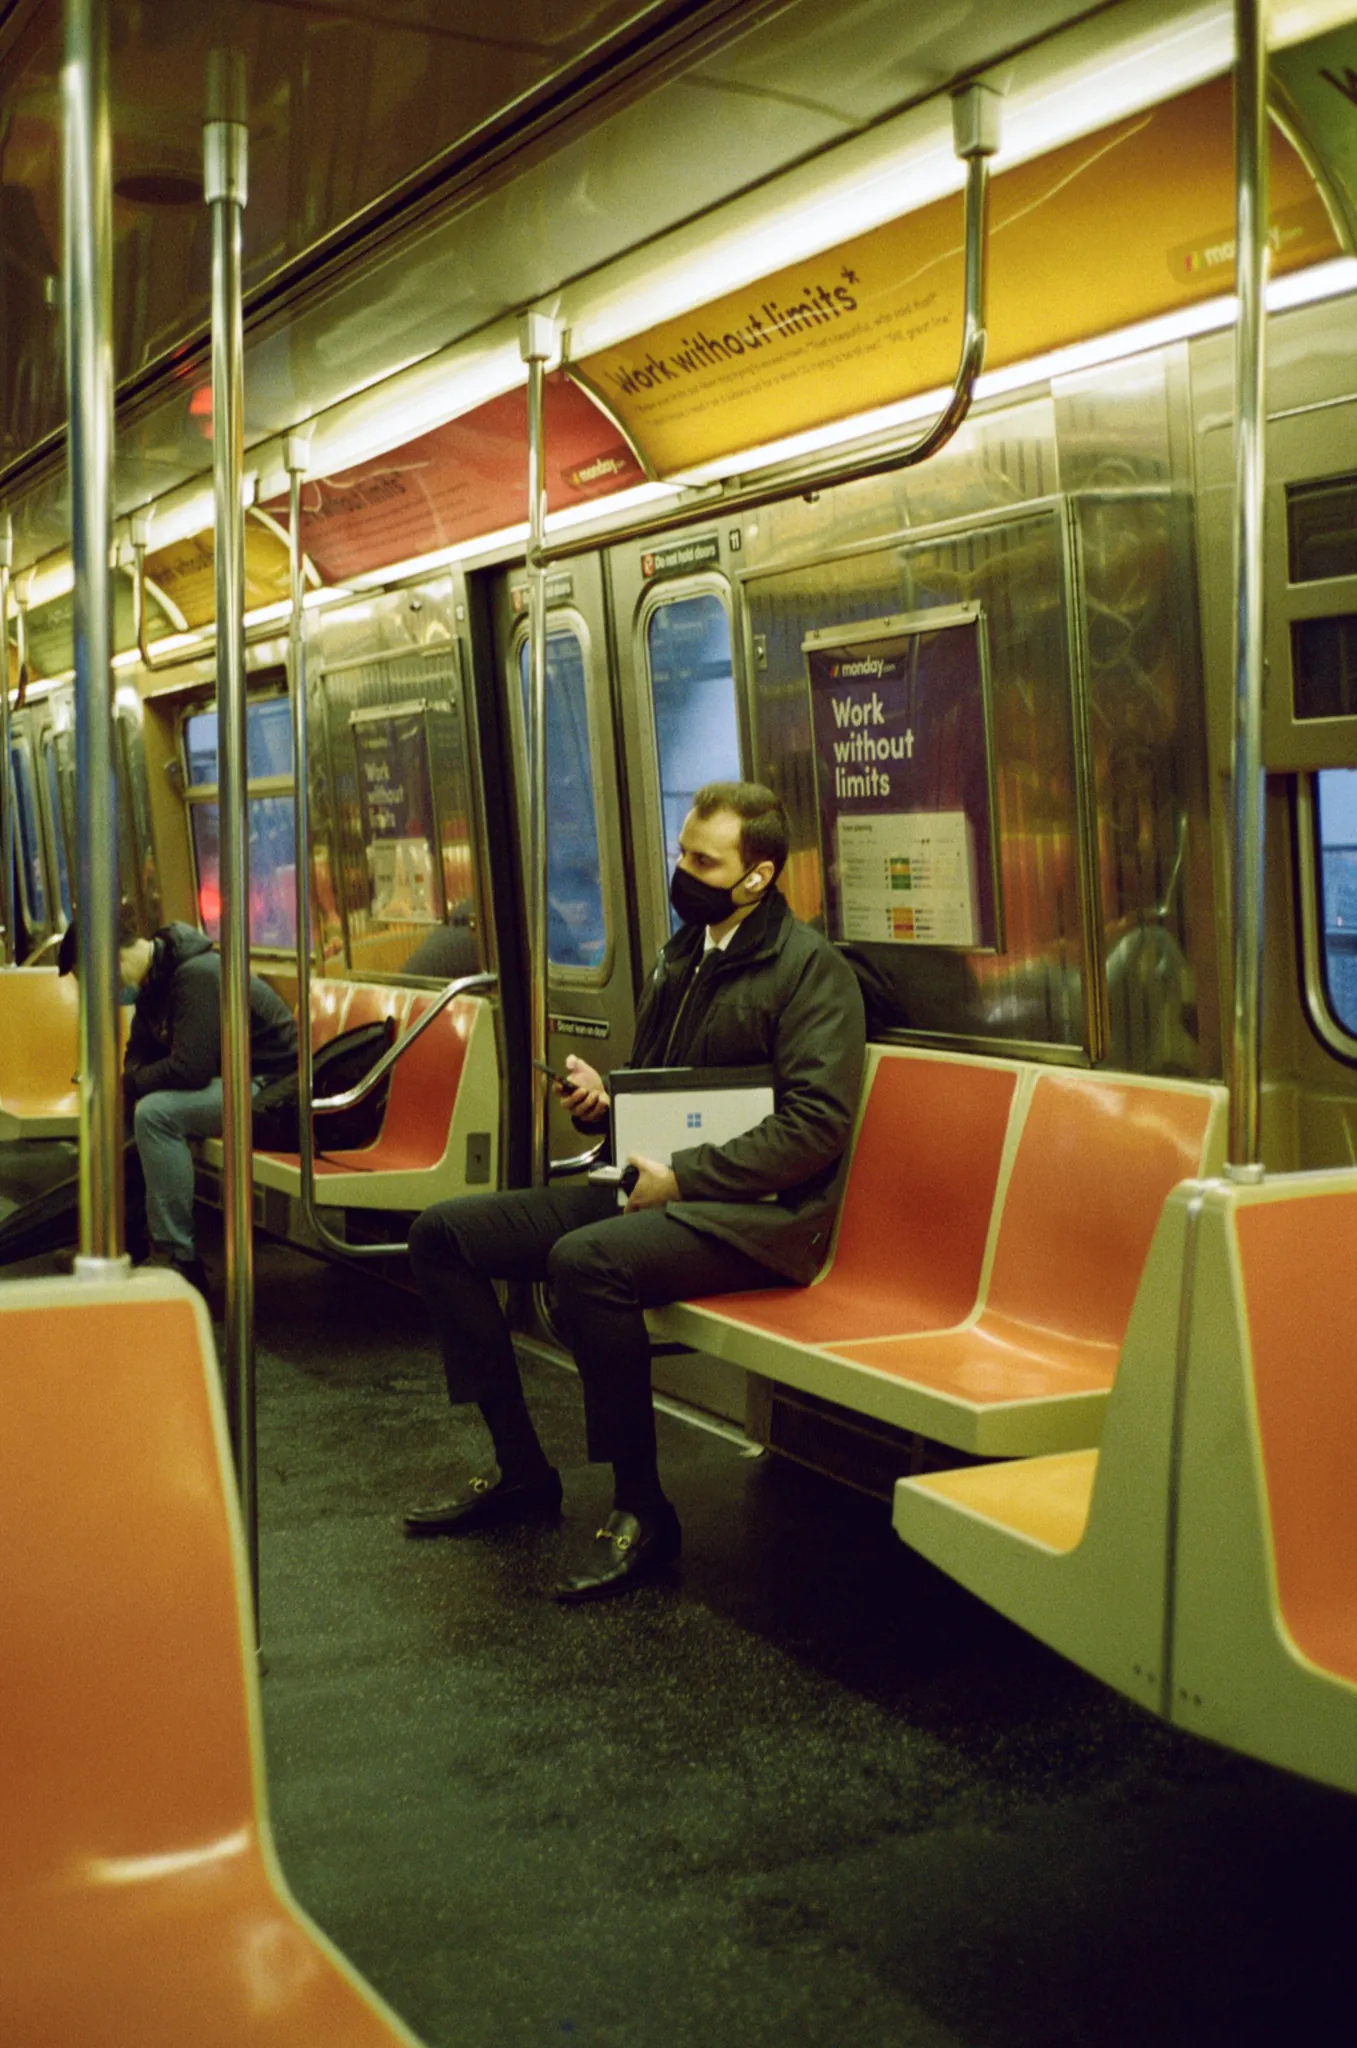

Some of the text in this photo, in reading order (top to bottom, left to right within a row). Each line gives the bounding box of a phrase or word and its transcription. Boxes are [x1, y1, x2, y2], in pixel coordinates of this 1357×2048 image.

[604, 352, 679, 396] Work
[669, 313, 771, 373] without
[832, 691, 885, 729] Work
[834, 728, 914, 763] without
[835, 765, 890, 798] limits
